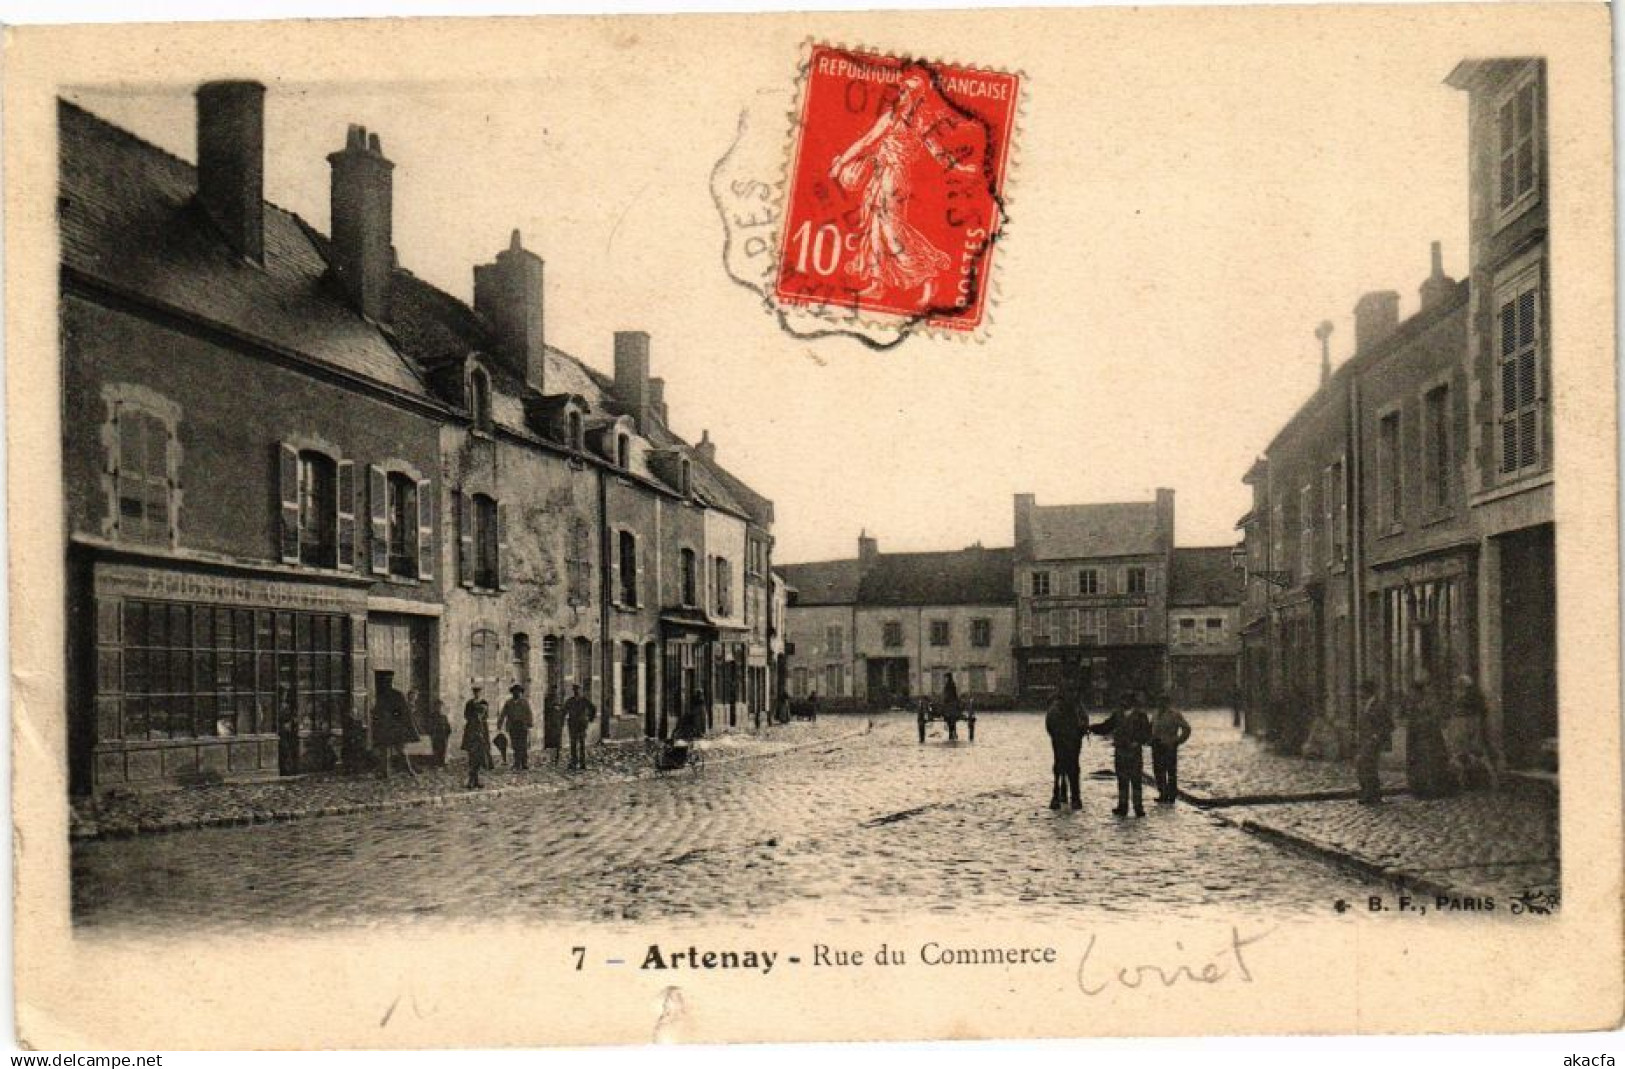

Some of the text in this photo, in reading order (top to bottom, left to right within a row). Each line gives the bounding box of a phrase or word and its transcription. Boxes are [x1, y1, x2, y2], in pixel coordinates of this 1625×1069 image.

[1435, 896, 1496, 912] PARIS
[571, 945, 587, 971] 7
[639, 943, 779, 975] Artenay
[813, 943, 864, 967] Rue
[874, 943, 905, 967] du
[919, 941, 1057, 966] Commerce
